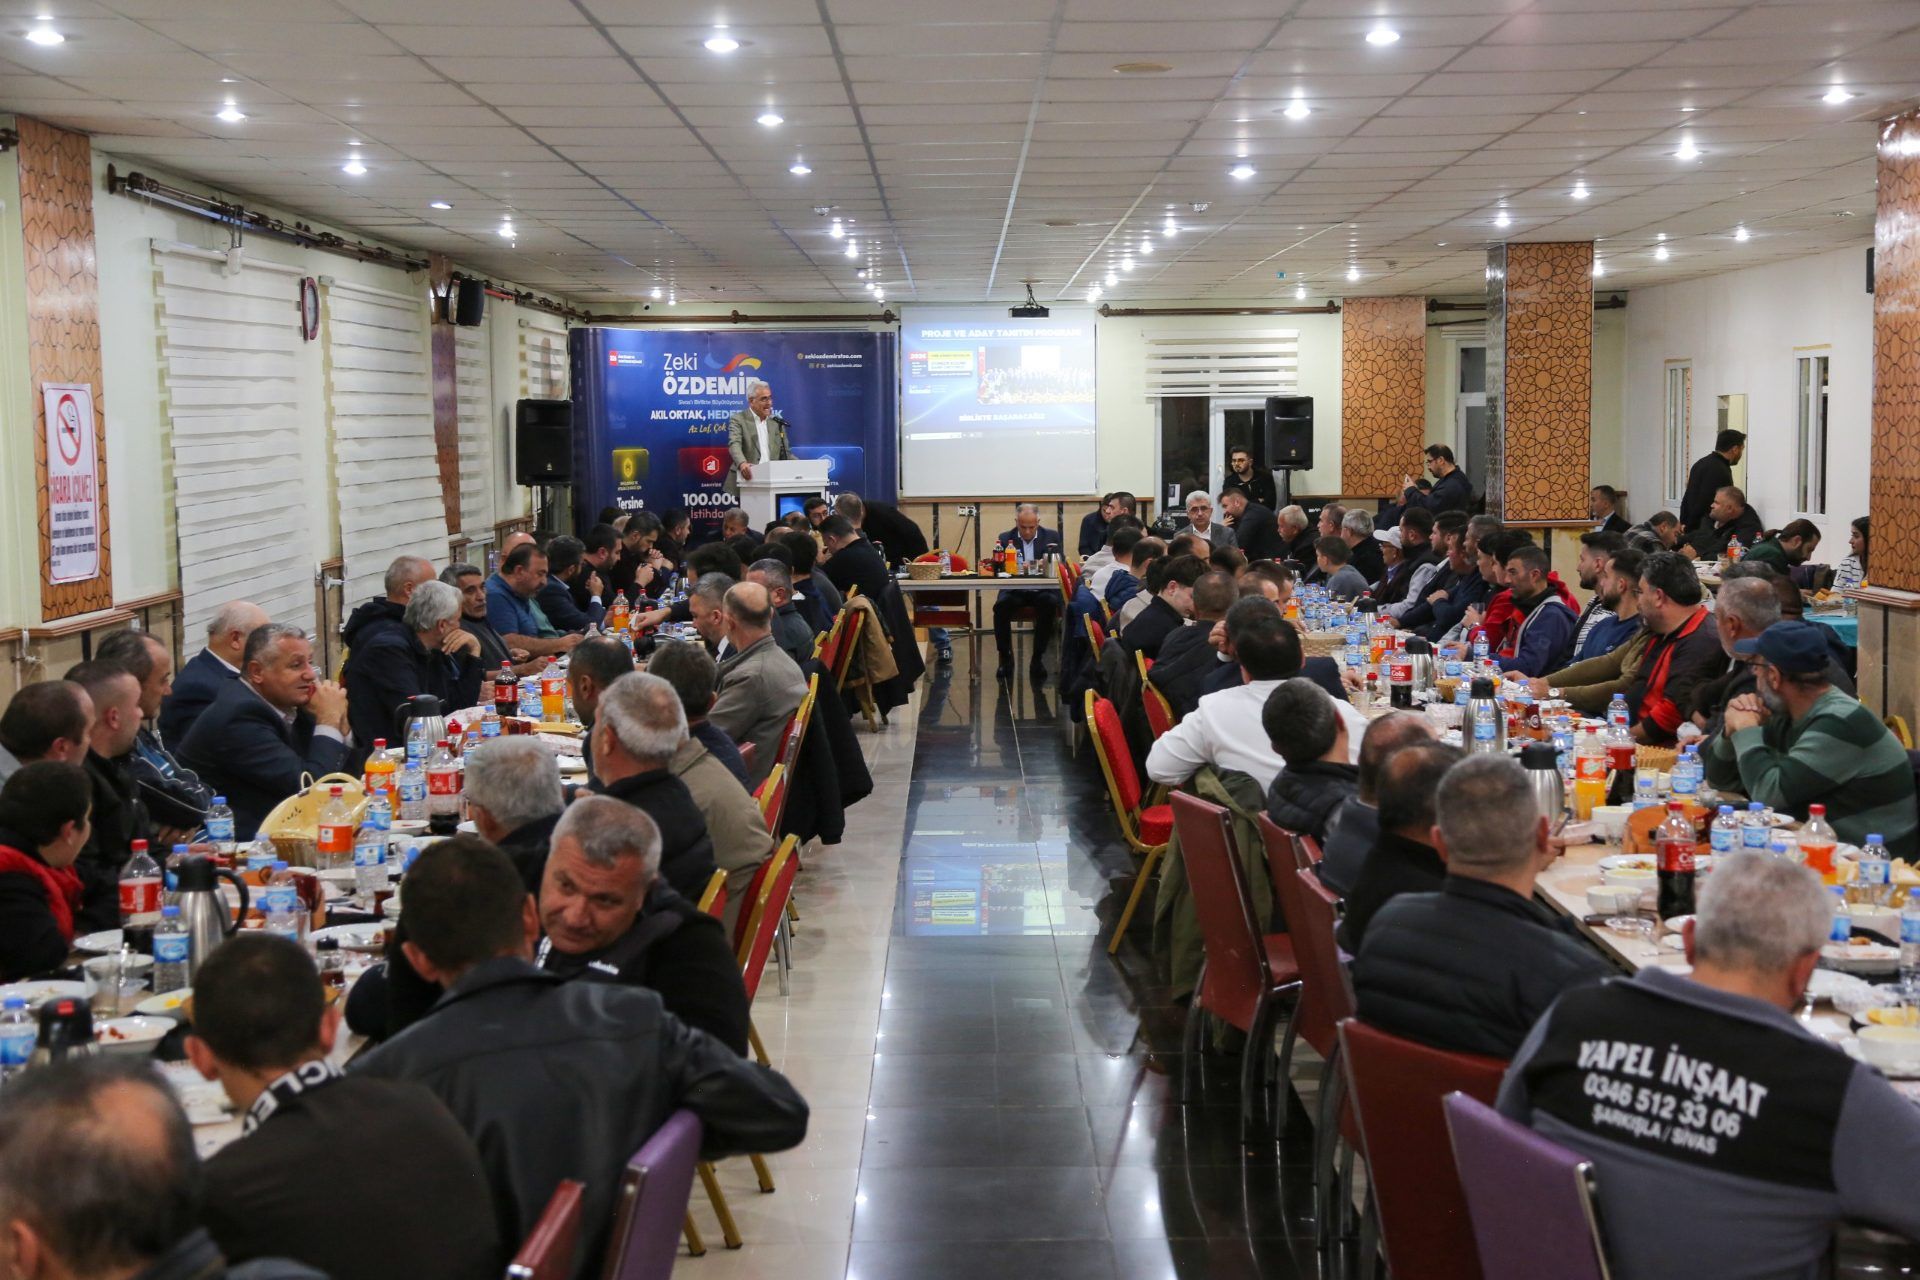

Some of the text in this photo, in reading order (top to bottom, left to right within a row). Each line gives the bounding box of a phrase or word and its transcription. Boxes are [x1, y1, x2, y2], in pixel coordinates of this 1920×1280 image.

[921, 330, 951, 338] PROJE
[954, 330, 967, 338] VE
[968, 329, 994, 337] ADAY
[663, 353, 698, 370] Zeki
[650, 410, 742, 421] AKIL ORTAK, HEDE
[617, 496, 644, 510] Tersine
[691, 507, 727, 519] İstihda
[1578, 1040, 1768, 1118] YAPEL İNŞAAT
[1583, 1073, 1741, 1138] 0346 512 33 06
[1592, 1103, 1661, 1138] ŞARKIŞLA
[1670, 1124, 1717, 1155] SİVAS
